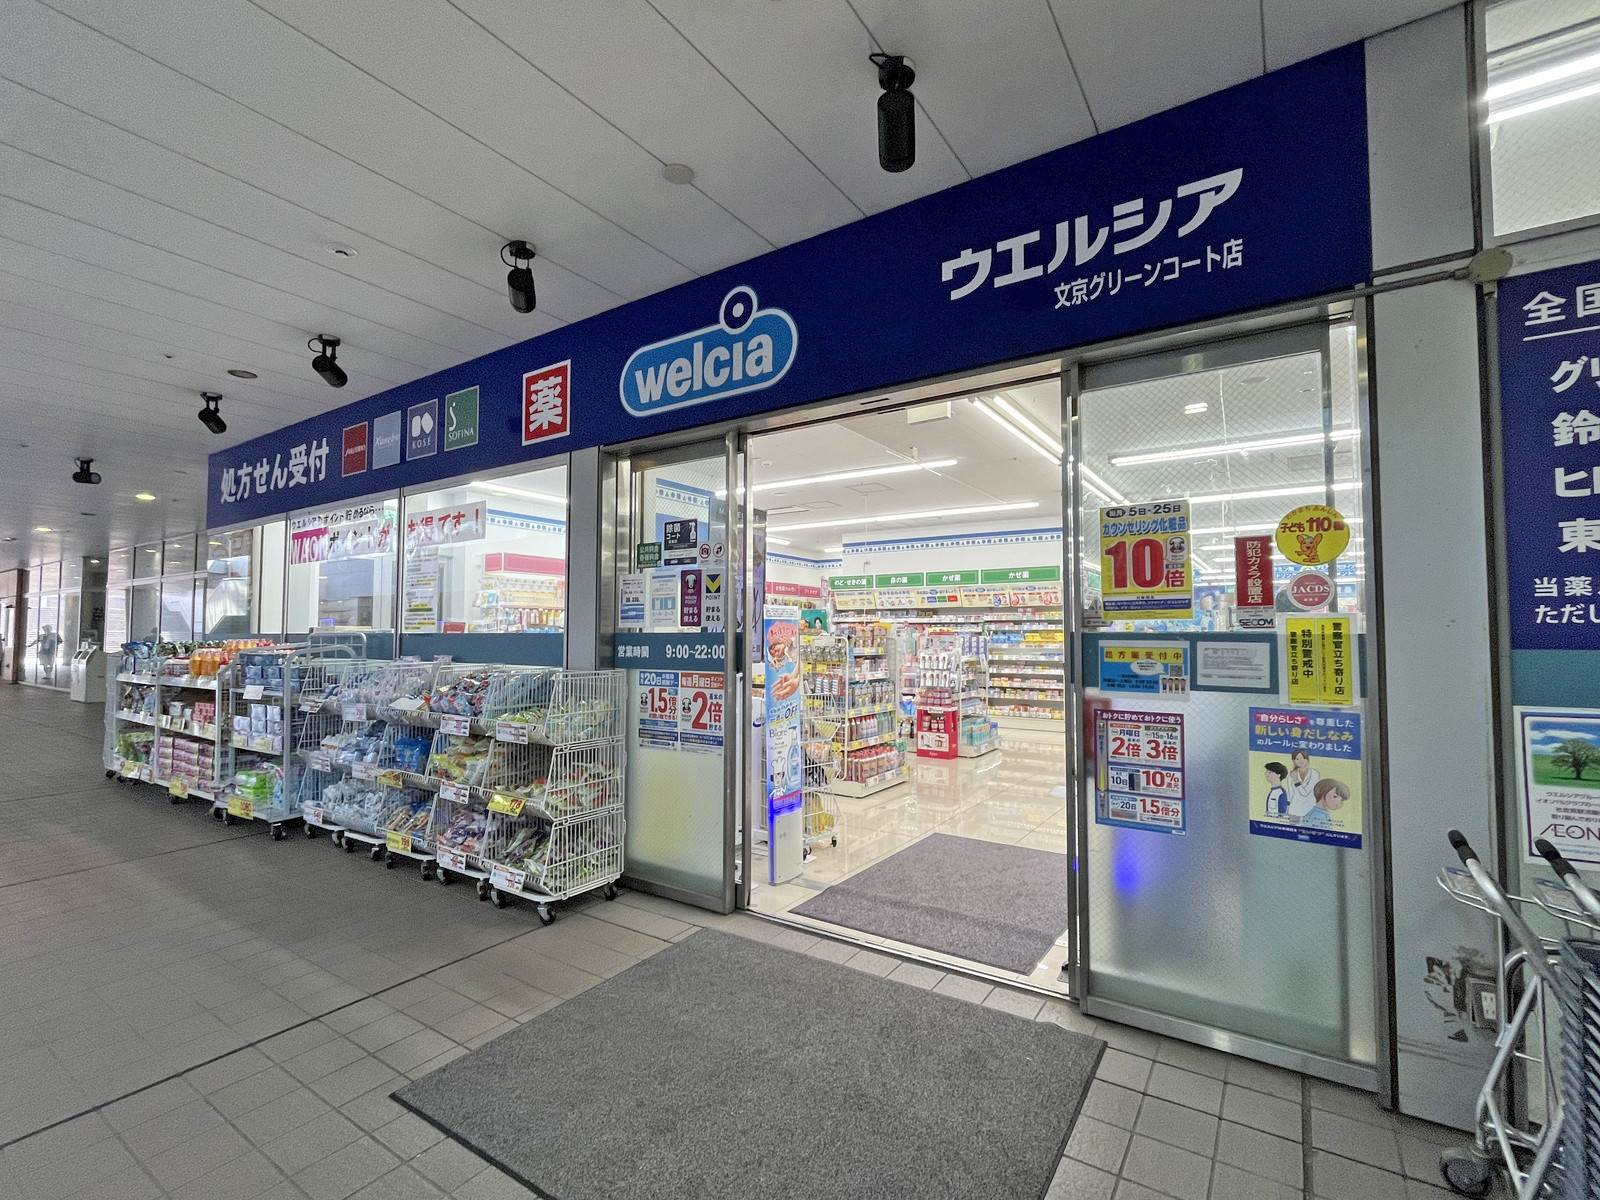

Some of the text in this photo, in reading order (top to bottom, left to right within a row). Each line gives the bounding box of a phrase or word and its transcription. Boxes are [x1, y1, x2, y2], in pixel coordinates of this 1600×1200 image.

[942, 168, 1243, 300] ウエルシア
[1055, 239, 1243, 309] 文京グリーンコート店
[635, 332, 775, 405] welcia
[529, 376, 563, 432] 薬
[448, 427, 474, 441] SOFINA
[220, 438, 330, 504] 処方せん受付
[1554, 465, 1600, 498] ヒ
[1103, 516, 1187, 537] カウンセリング化粧品
[1105, 539, 1185, 589] 10 倍
[1246, 541, 1263, 603] 防犯カメラ設置店
[1008, 571, 1030, 579] かぜ薬
[1292, 584, 1330, 593] JACDS
[1534, 575, 1600, 598] 当薬
[1239, 619, 1273, 627] SECOM
[617, 645, 650, 658] 営業時間
[1290, 632, 1298, 685] 警察官立ち寄り店
[1301, 629, 1313, 678] 特別警戒中
[1332, 622, 1344, 695] 警察官立ち寄り店
[649, 688, 668, 713] 1.5
[692, 691, 722, 730] 2 倍
[1102, 711, 1182, 724] おトクに貯めておトクに使う
[1119, 729, 1140, 737] 月曜日
[1255, 725, 1354, 741] 新しい身だしなみ
[1111, 737, 1126, 756] 2
[1126, 743, 1141, 757] 倍
[1146, 739, 1178, 760] 3 倍
[1256, 738, 1352, 752] のルールに変わりました
[1111, 770, 1180, 787] 10日 10%
[1120, 801, 1136, 810] 20日
[1140, 798, 1160, 814] 1.5
